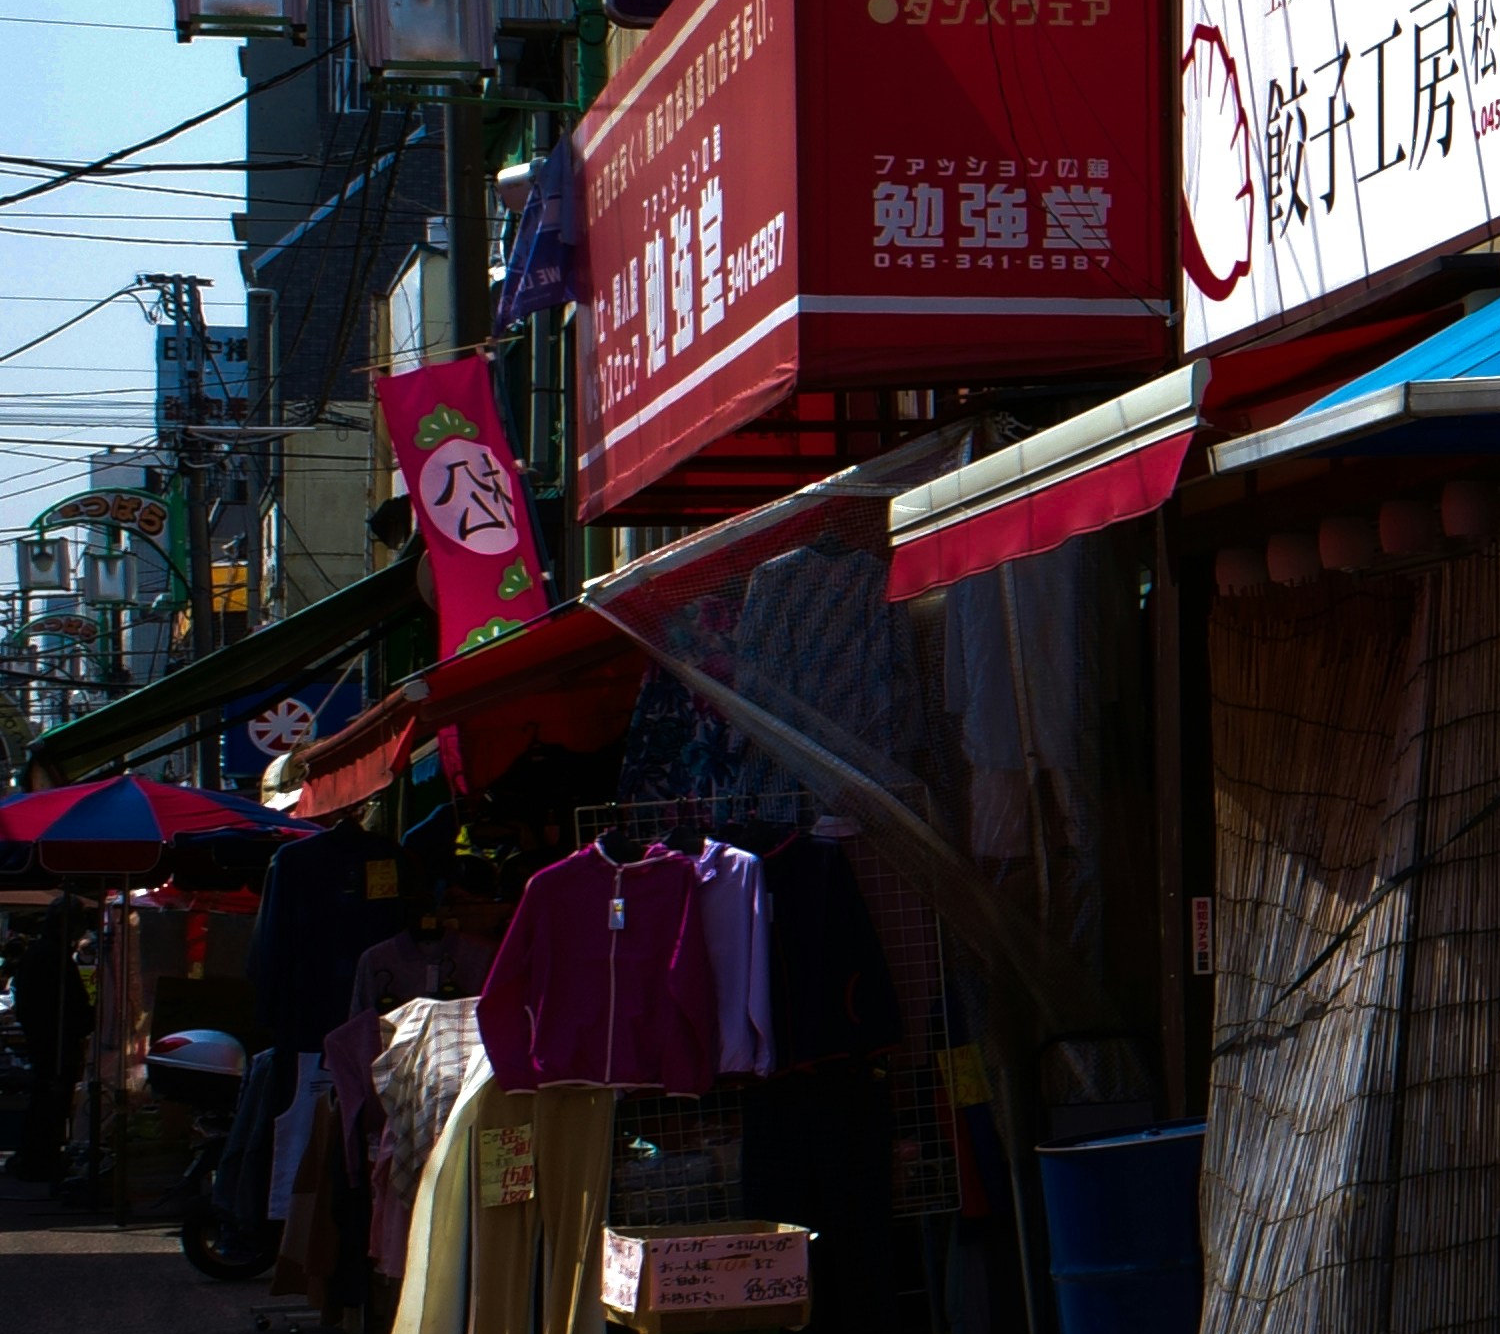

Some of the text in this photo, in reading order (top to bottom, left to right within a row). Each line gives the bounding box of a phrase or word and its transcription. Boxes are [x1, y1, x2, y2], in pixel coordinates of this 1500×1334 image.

[873, 155, 1110, 179] ファッションの館
[872, 180, 1112, 249] 勉強堂
[645, 176, 725, 378] 勉強堂
[727, 211, 785, 306] 341-6987
[874, 252, 1111, 271] 045-341-6987
